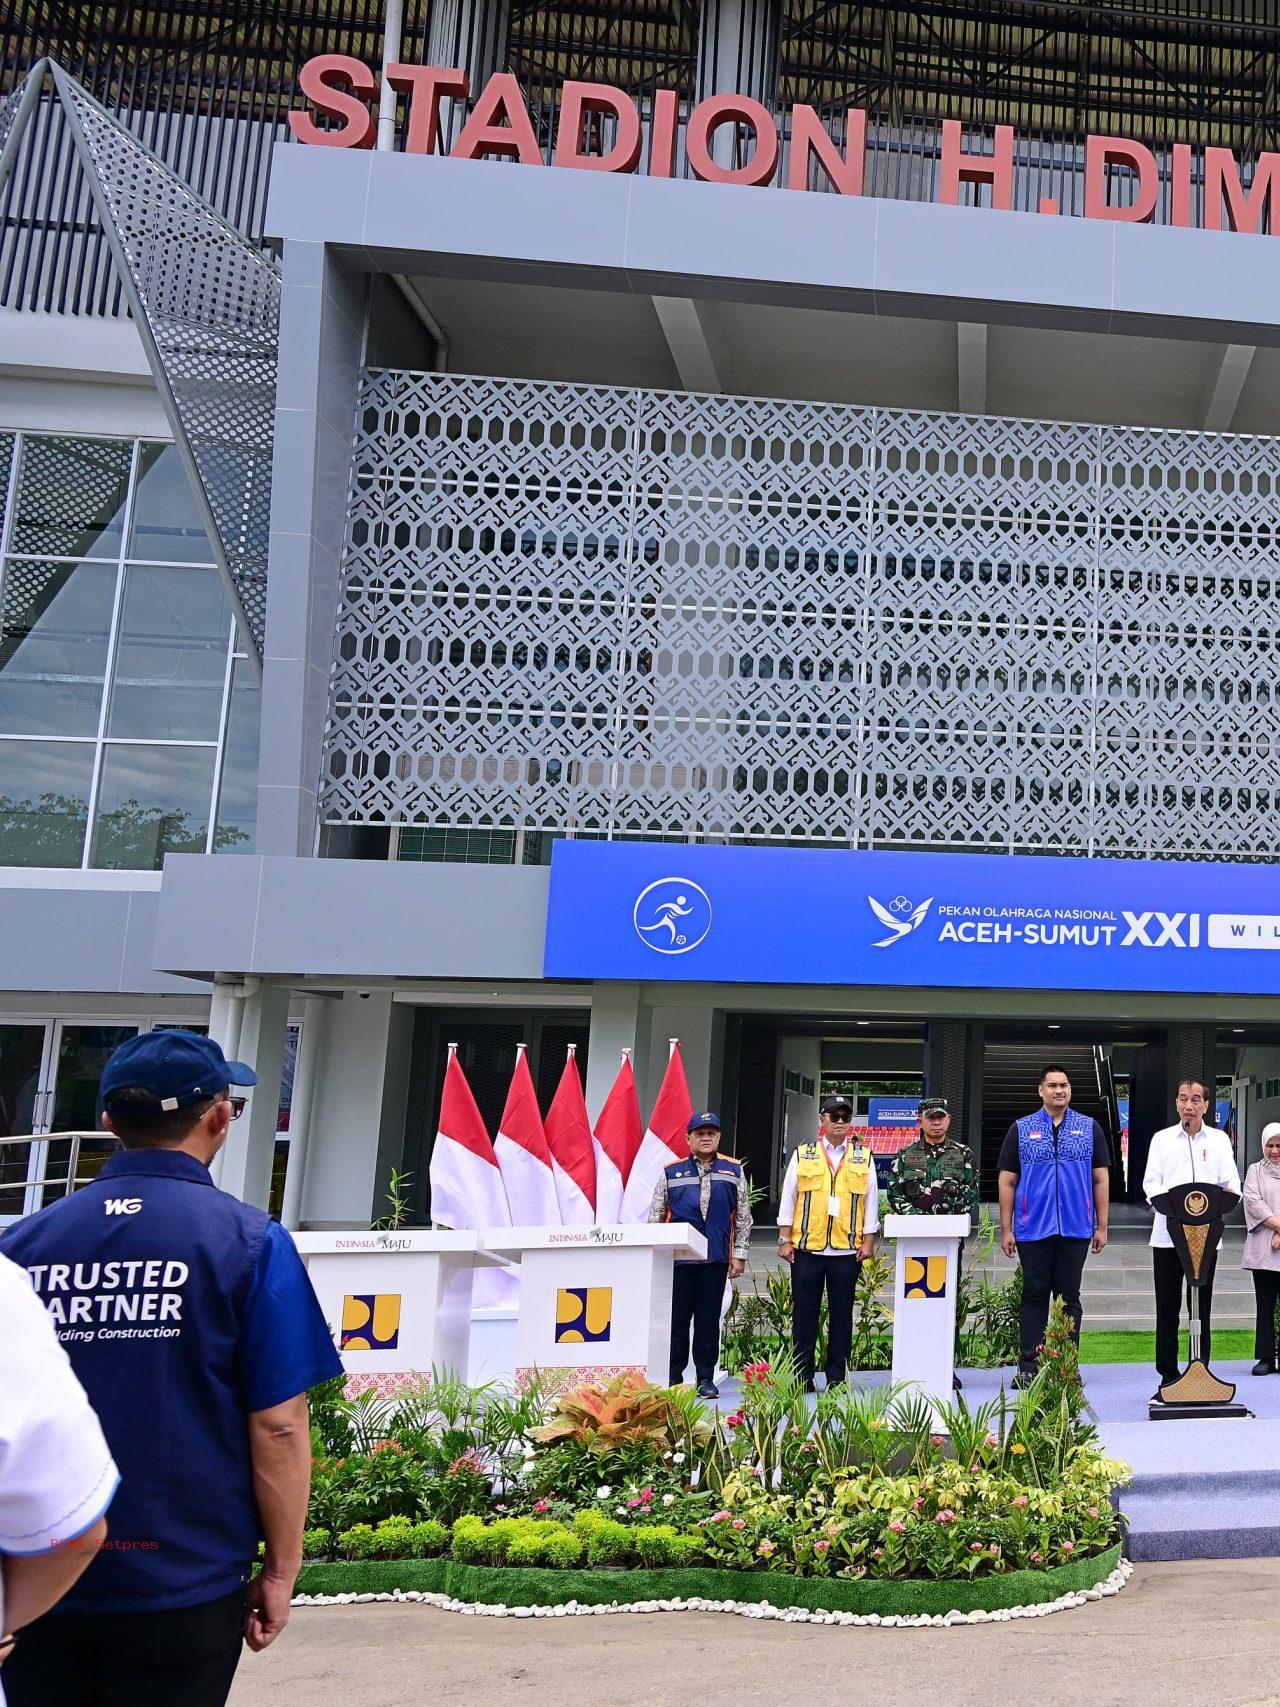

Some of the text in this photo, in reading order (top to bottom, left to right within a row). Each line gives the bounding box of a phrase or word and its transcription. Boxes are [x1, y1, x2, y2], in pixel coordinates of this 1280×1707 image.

[288, 54, 867, 197] STADION
[941, 119, 1058, 215] H.
[938, 905, 1118, 921] PEKAN OLAHRAGA NASIONAL
[937, 911, 1200, 948] ACEH-SUMUT XXI
[103, 1198, 144, 1216] WG
[381, 1239, 412, 1250] MAJU
[594, 1232, 624, 1245] MAJU
[26, 1260, 190, 1293] TRUSTED
[46, 1293, 184, 1325] ARTNER
[57, 1326, 181, 1343] lding Construction
